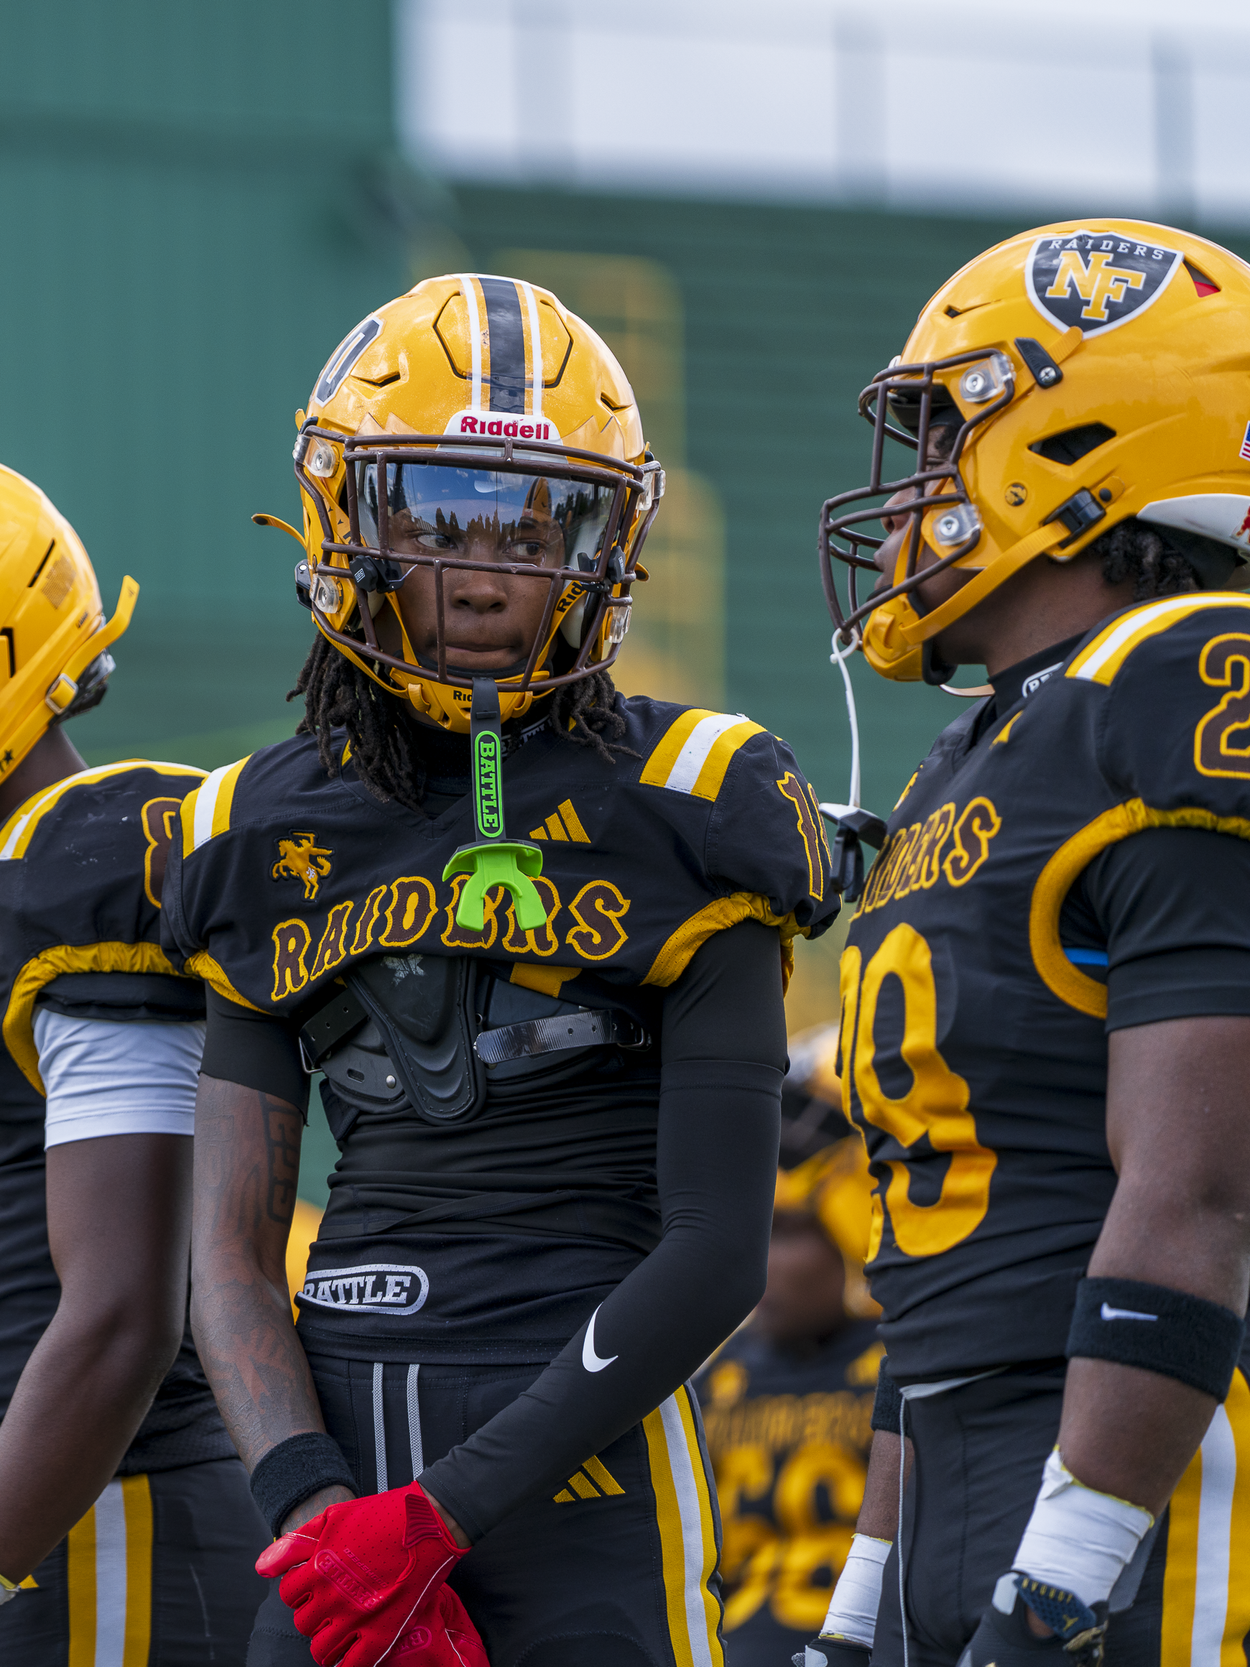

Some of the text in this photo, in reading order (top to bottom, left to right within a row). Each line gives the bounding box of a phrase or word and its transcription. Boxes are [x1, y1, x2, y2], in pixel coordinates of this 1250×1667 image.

[1048, 238, 1165, 261] RAIDERS
[1045, 250, 1147, 322] NF
[461, 416, 550, 440] Riddell
[480, 742, 499, 828] BATTLE
